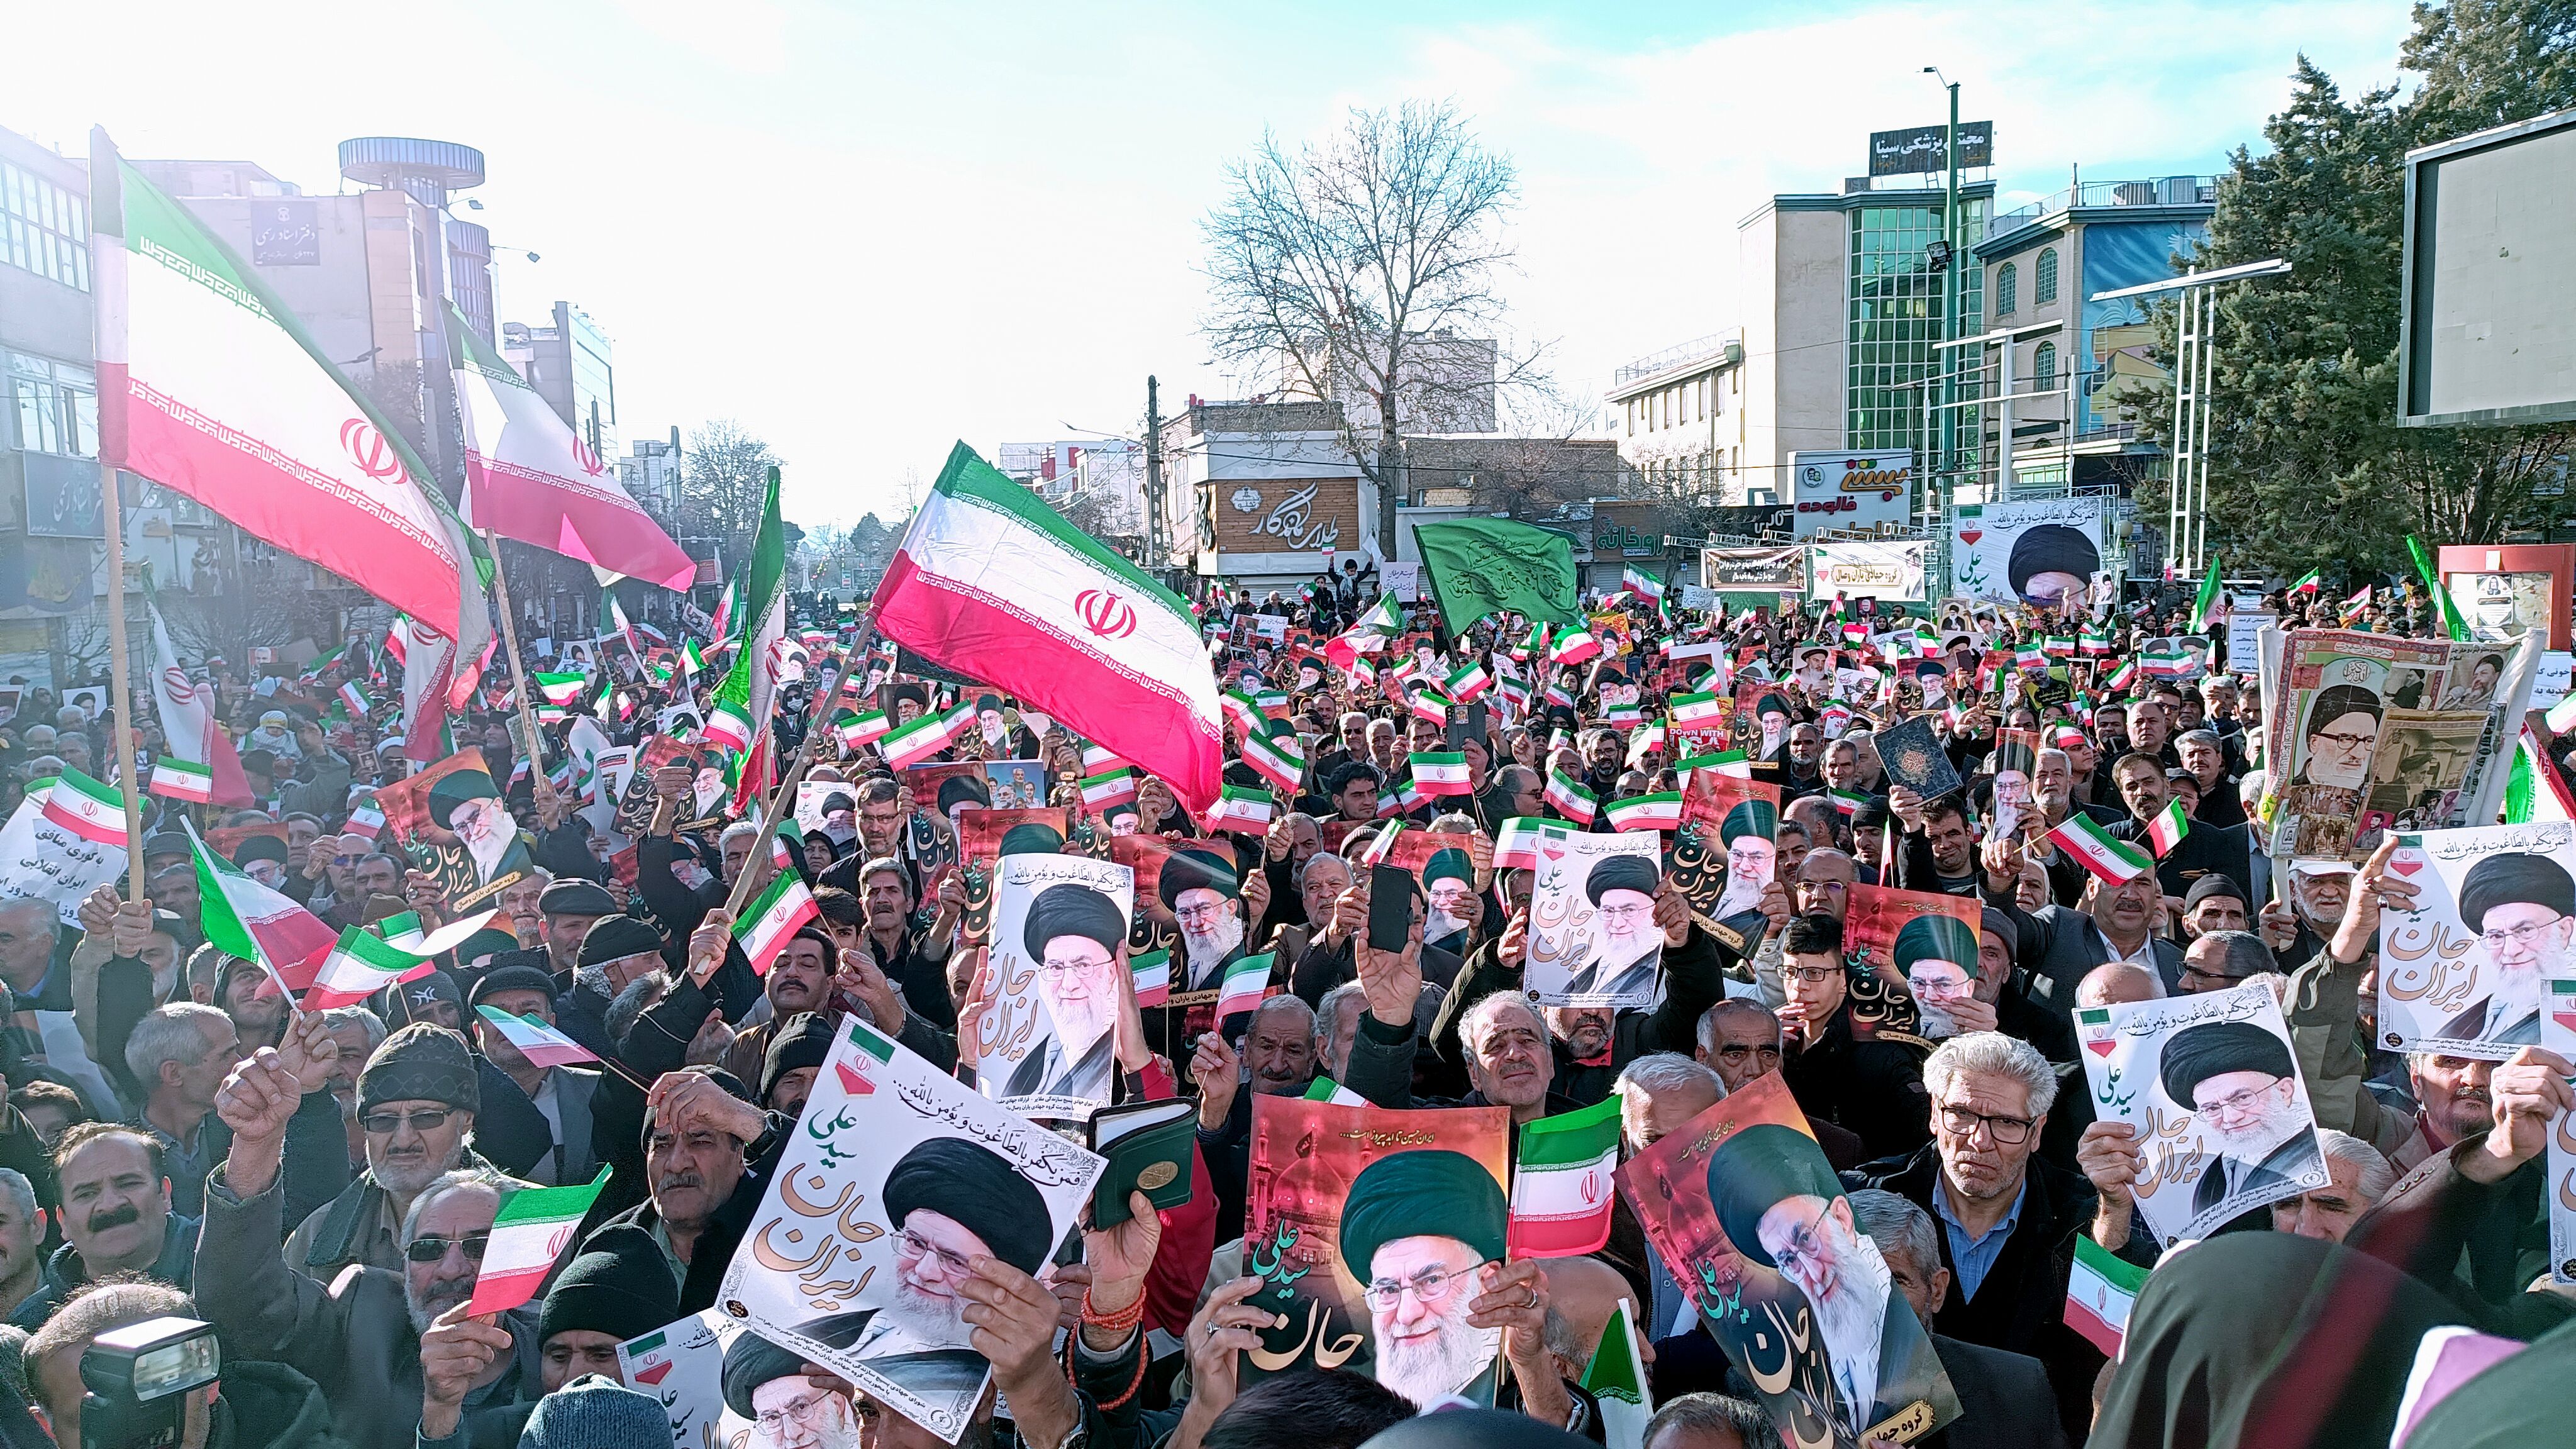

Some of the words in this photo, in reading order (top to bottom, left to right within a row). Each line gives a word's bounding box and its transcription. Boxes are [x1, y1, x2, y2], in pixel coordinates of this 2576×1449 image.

[1876, 139, 1899, 158] سینا
[1901, 133, 1943, 156] پزشکی
[279, 228, 298, 240] اسناد
[294, 224, 315, 246] دفتر
[1798, 496, 1858, 514] فالوده
[1596, 525, 1667, 557] روخانه
[1835, 569, 1851, 583] وصال
[1851, 570, 1865, 582] یاران
[1865, 569, 1884, 582] جهادی
[1885, 570, 1897, 584] گروه
[1959, 550, 1982, 583] علی
[1968, 572, 1990, 593] سید
[2546, 668, 2570, 677] خونی
[1902, 685, 1922, 699] جان
[1700, 730, 1724, 738] WITH
[1735, 724, 1762, 741] جان
[916, 826, 952, 850] جان
[1680, 818, 1705, 836] علی
[1080, 832, 1110, 854] جان
[1689, 833, 1707, 846] سید
[66, 847, 99, 863] کوری
[95, 857, 104, 868] به
[418, 845, 462, 880] جان
[1674, 845, 1724, 880] جان
[20, 858, 62, 877] انقلابی
[963, 855, 982, 879] علی
[1539, 865, 1563, 890] علی
[57, 875, 87, 891] ایران
[501, 872, 516, 886] گروه
[1547, 883, 1568, 897] سید
[1668, 870, 1723, 909] ایران
[1535, 895, 1594, 937] جان
[1128, 921, 1177, 955] جان
[1709, 924, 1728, 938] جهادی
[1532, 928, 1595, 972] ایران
[1846, 943, 1872, 967] علی
[2387, 921, 2475, 972] جان
[1856, 963, 1878, 977] سید
[1850, 978, 1908, 1010] جان
[2385, 962, 2478, 1012] ایران
[1853, 1004, 1915, 1030] ایران
[979, 999, 1038, 1062] ایران
[2097, 1063, 2123, 1106] علی
[2111, 1088, 2136, 1116] سید
[808, 1104, 858, 1140] علی
[1370, 1130, 1387, 1147] پیروز
[1385, 1133, 1394, 1146] ابد
[1401, 1130, 1420, 1145] حسین
[1416, 1133, 1435, 1145] ایران
[816, 1140, 858, 1169] سید
[2132, 1135, 2204, 1199] ایران
[780, 1162, 884, 1262] جان
[1252, 1218, 1299, 1277] علی
[753, 1216, 877, 1311] ایران
[1269, 1263, 1311, 1299] سید
[1694, 1260, 1724, 1321] علی
[1726, 1280, 1750, 1324] سید
[794, 1335, 814, 1345] جهادی
[1247, 1297, 1365, 1372] جان
[1743, 1299, 1816, 1395] جان
[832, 1360, 851, 1372] جهادی
[837, 1355, 852, 1365] ملایر
[852, 1362, 875, 1380] سازندگی
[851, 1367, 863, 1379] گروه
[889, 1381, 908, 1397] جهادی
[670, 1406, 694, 1441] سید
[1899, 1407, 1923, 1436] گروه
